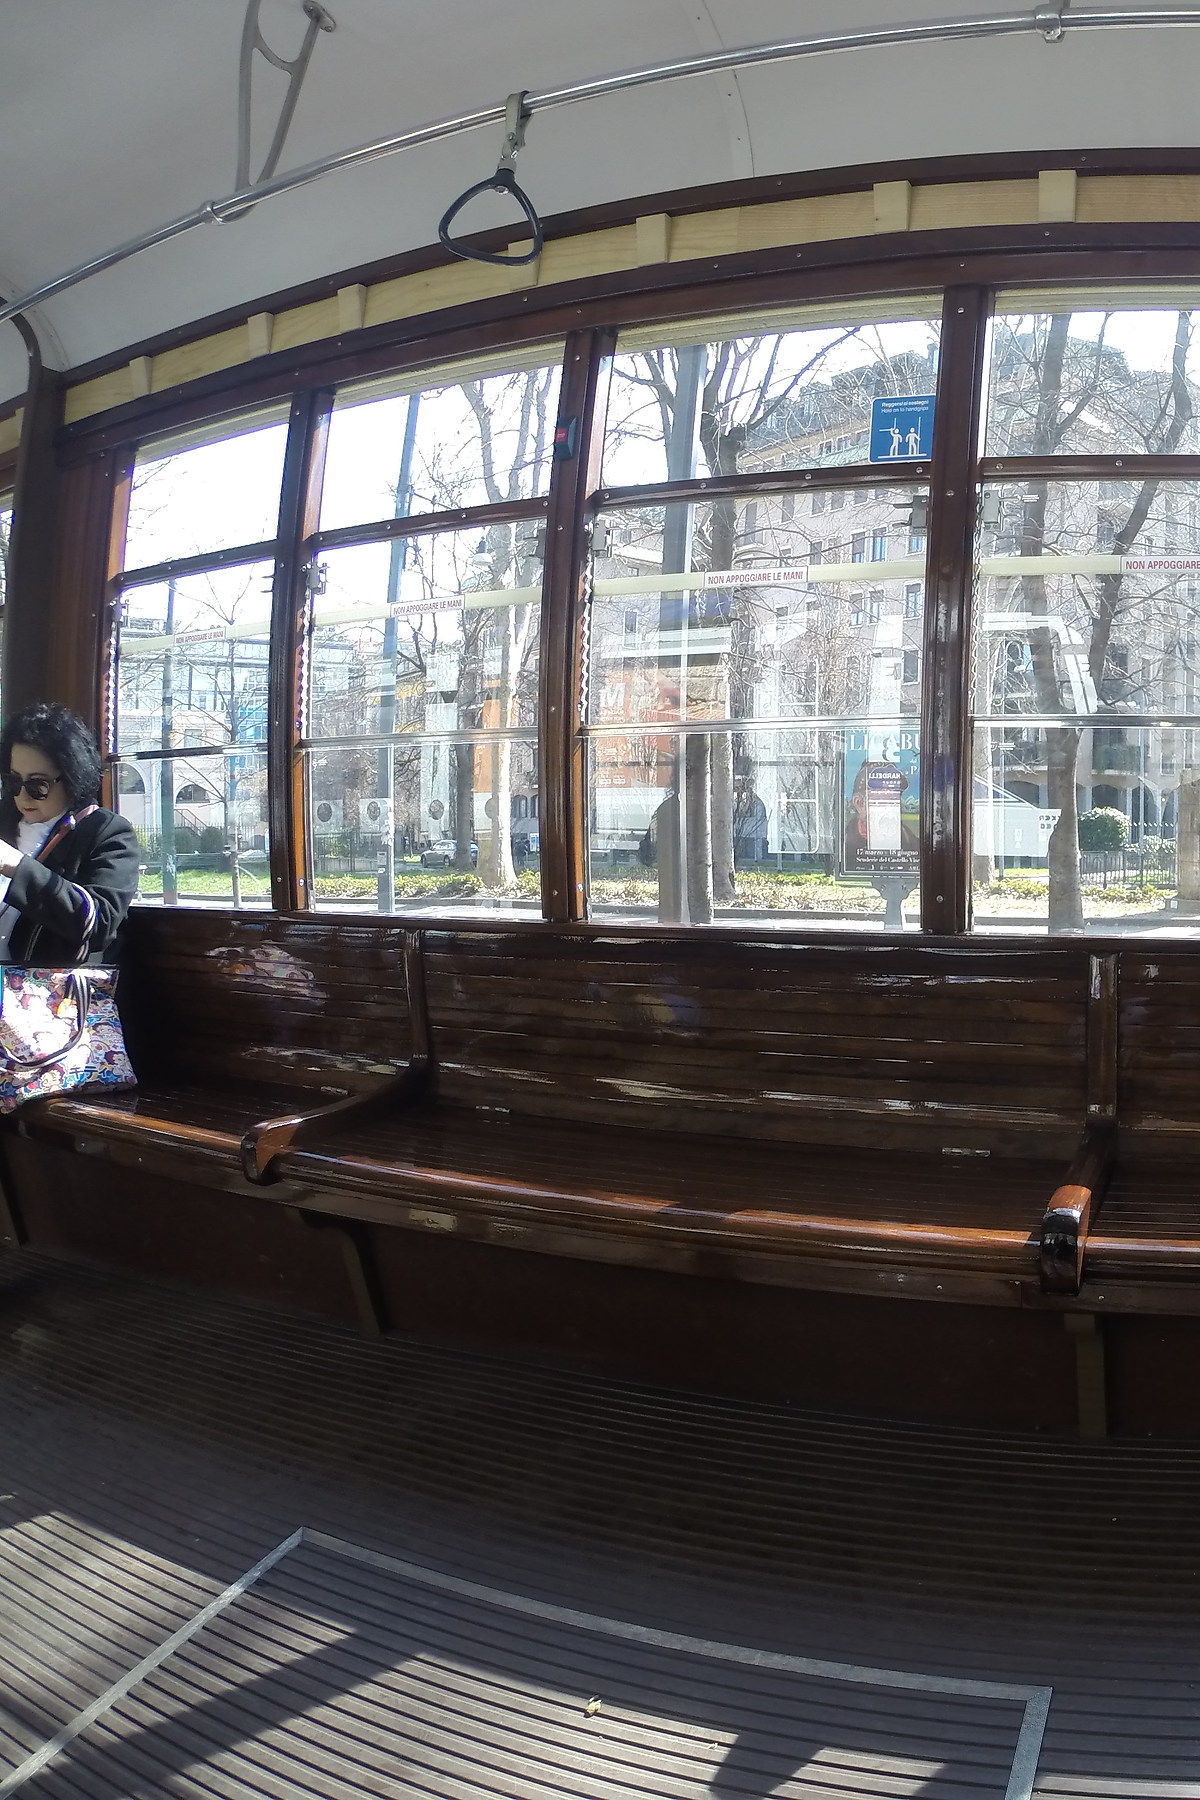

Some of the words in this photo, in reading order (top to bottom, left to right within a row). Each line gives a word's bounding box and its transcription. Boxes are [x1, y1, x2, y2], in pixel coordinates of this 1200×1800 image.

[1126, 561, 1145, 570] NON
[708, 575, 725, 585] NON
[726, 572, 772, 584] APPOGGIARE
[773, 572, 782, 581] LE
[783, 571, 803, 580] MANI
[393, 606, 406, 615] NON
[406, 602, 439, 613] APPOGGIARE
[440, 600, 447, 609] LE
[447, 599, 462, 608] MANI
[897, 849, 919, 857] giugno
